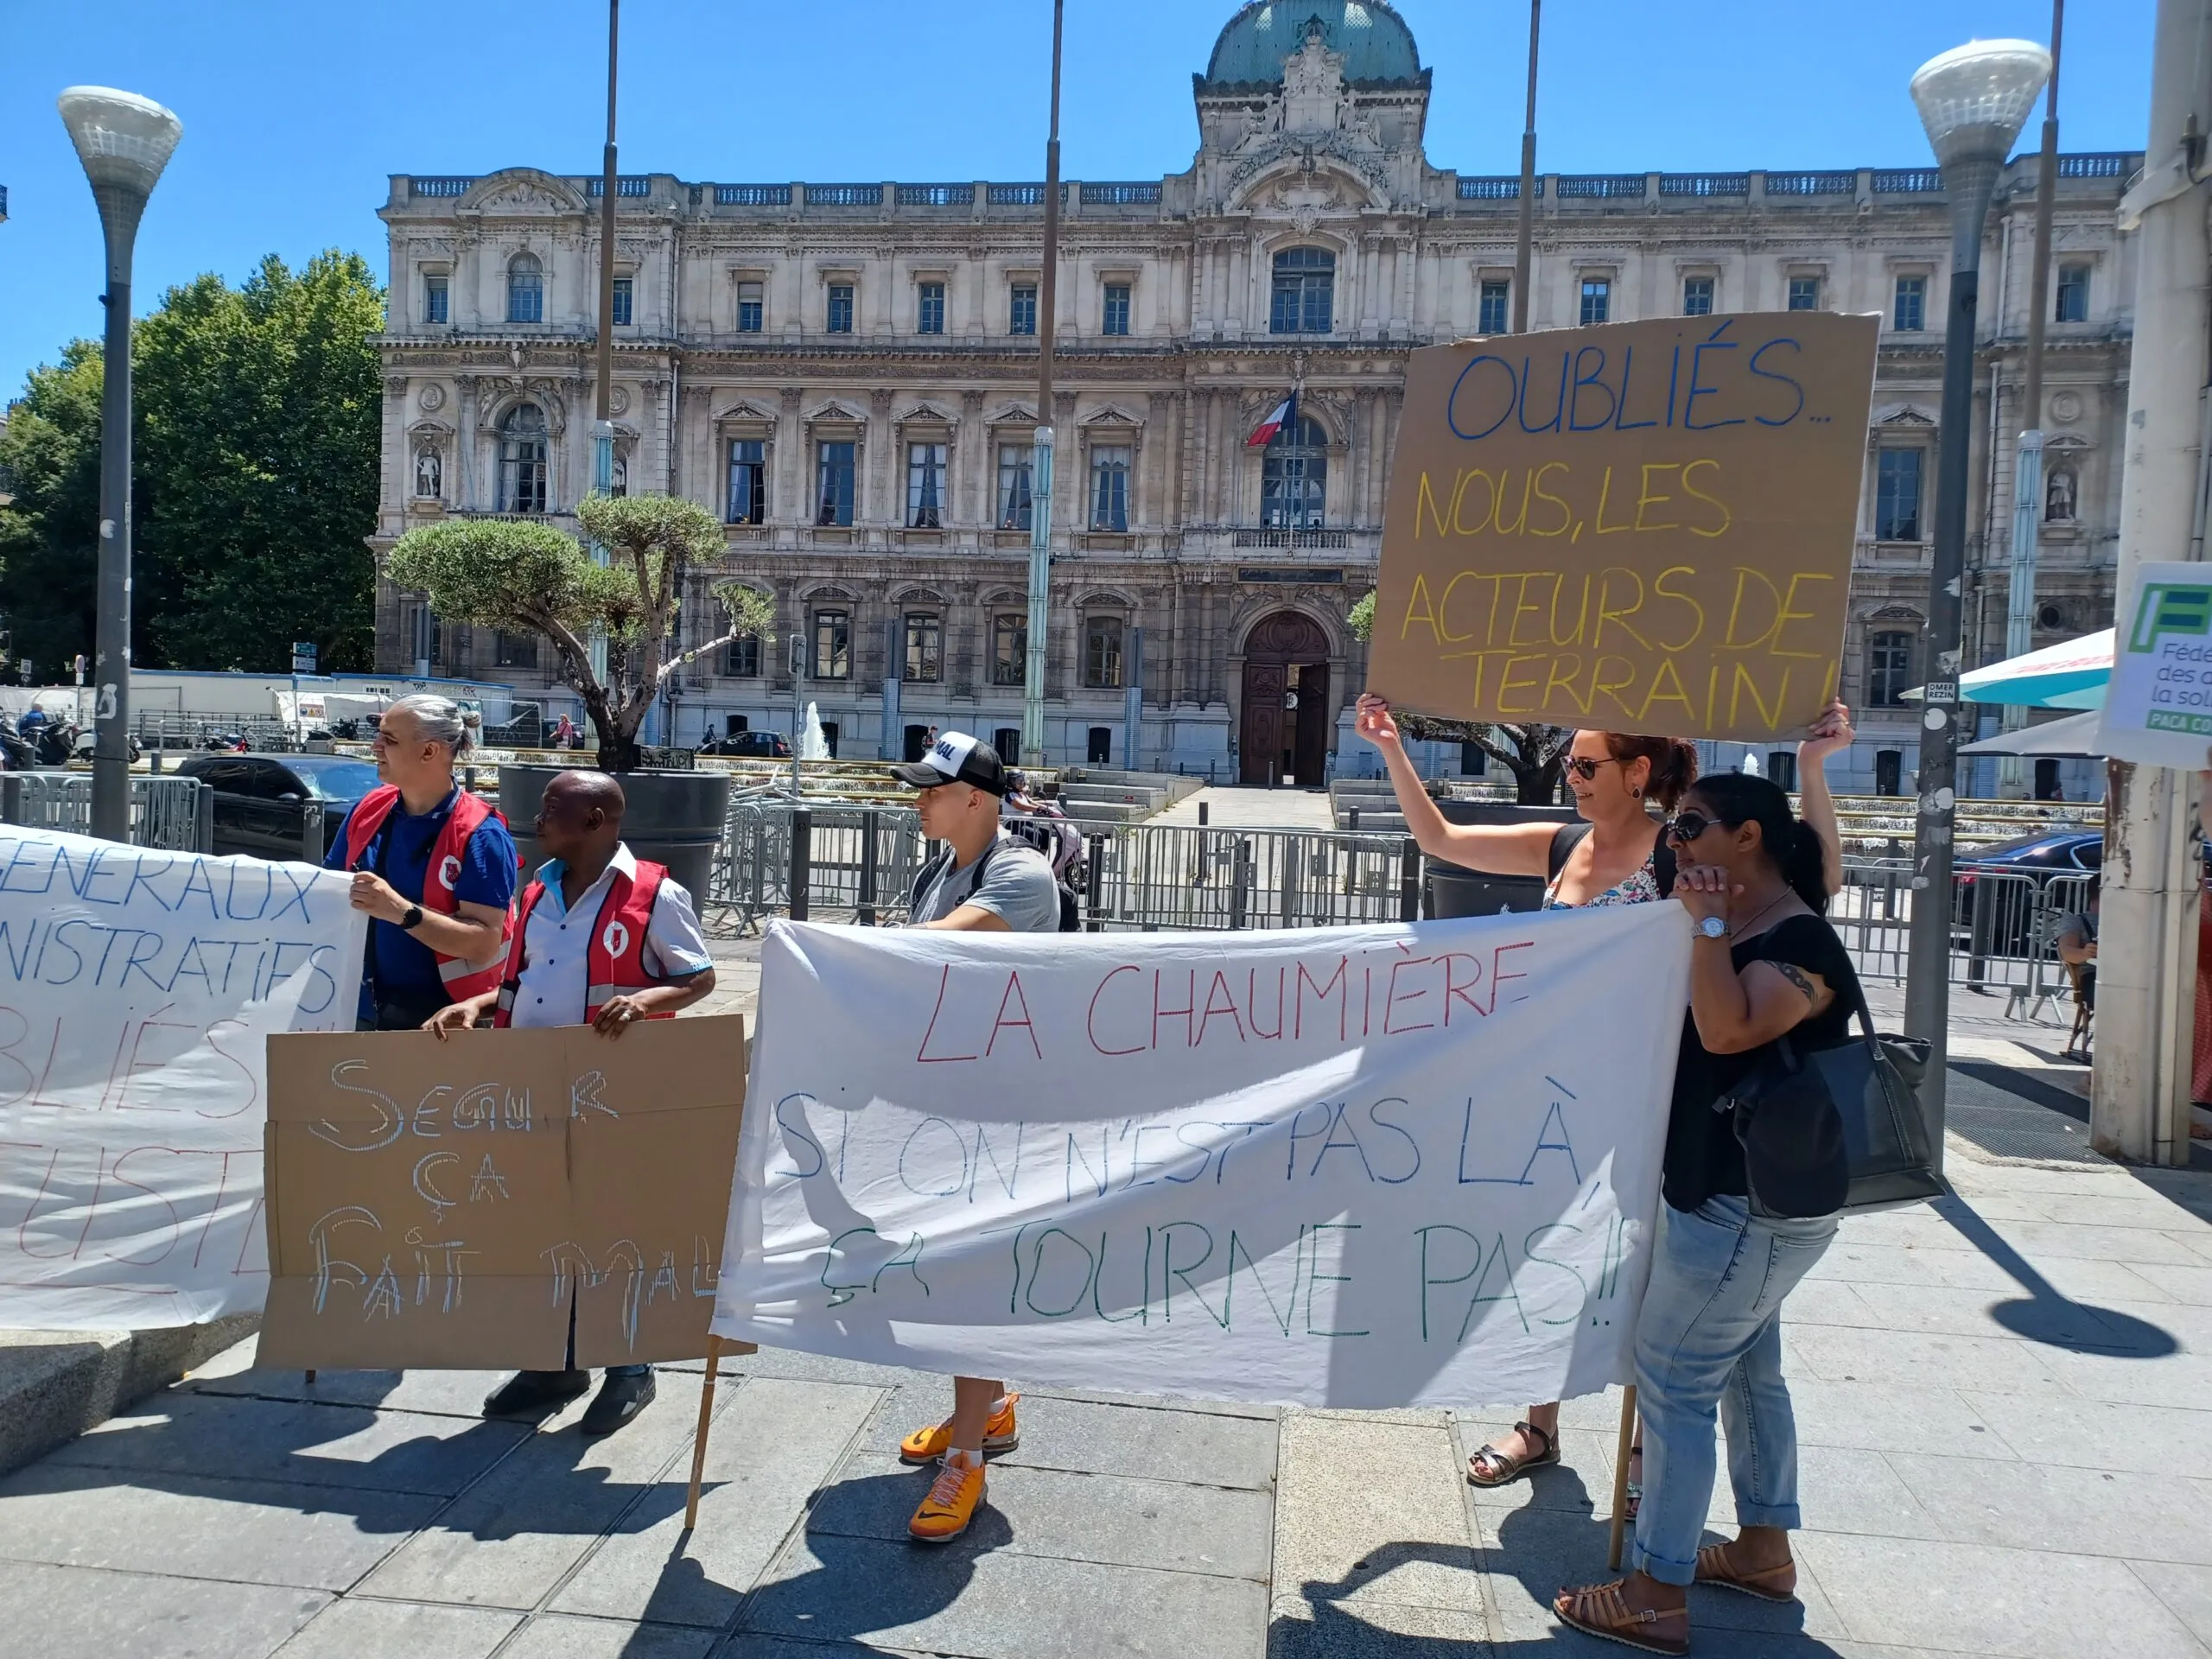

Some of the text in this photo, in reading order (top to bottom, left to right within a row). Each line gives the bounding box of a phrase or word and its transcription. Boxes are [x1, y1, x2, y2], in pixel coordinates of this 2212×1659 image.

[1401, 566, 1834, 657] ACTEURS DE
[2152, 684, 2172, 703] la
[2157, 664, 2196, 683] des
[2150, 713, 2188, 728] PACA
[917, 963, 1041, 1063] LA
[899, 1116, 1023, 1204] ON
[1287, 1096, 1421, 1184] PAS
[980, 1217, 1370, 1338] TOURNE
